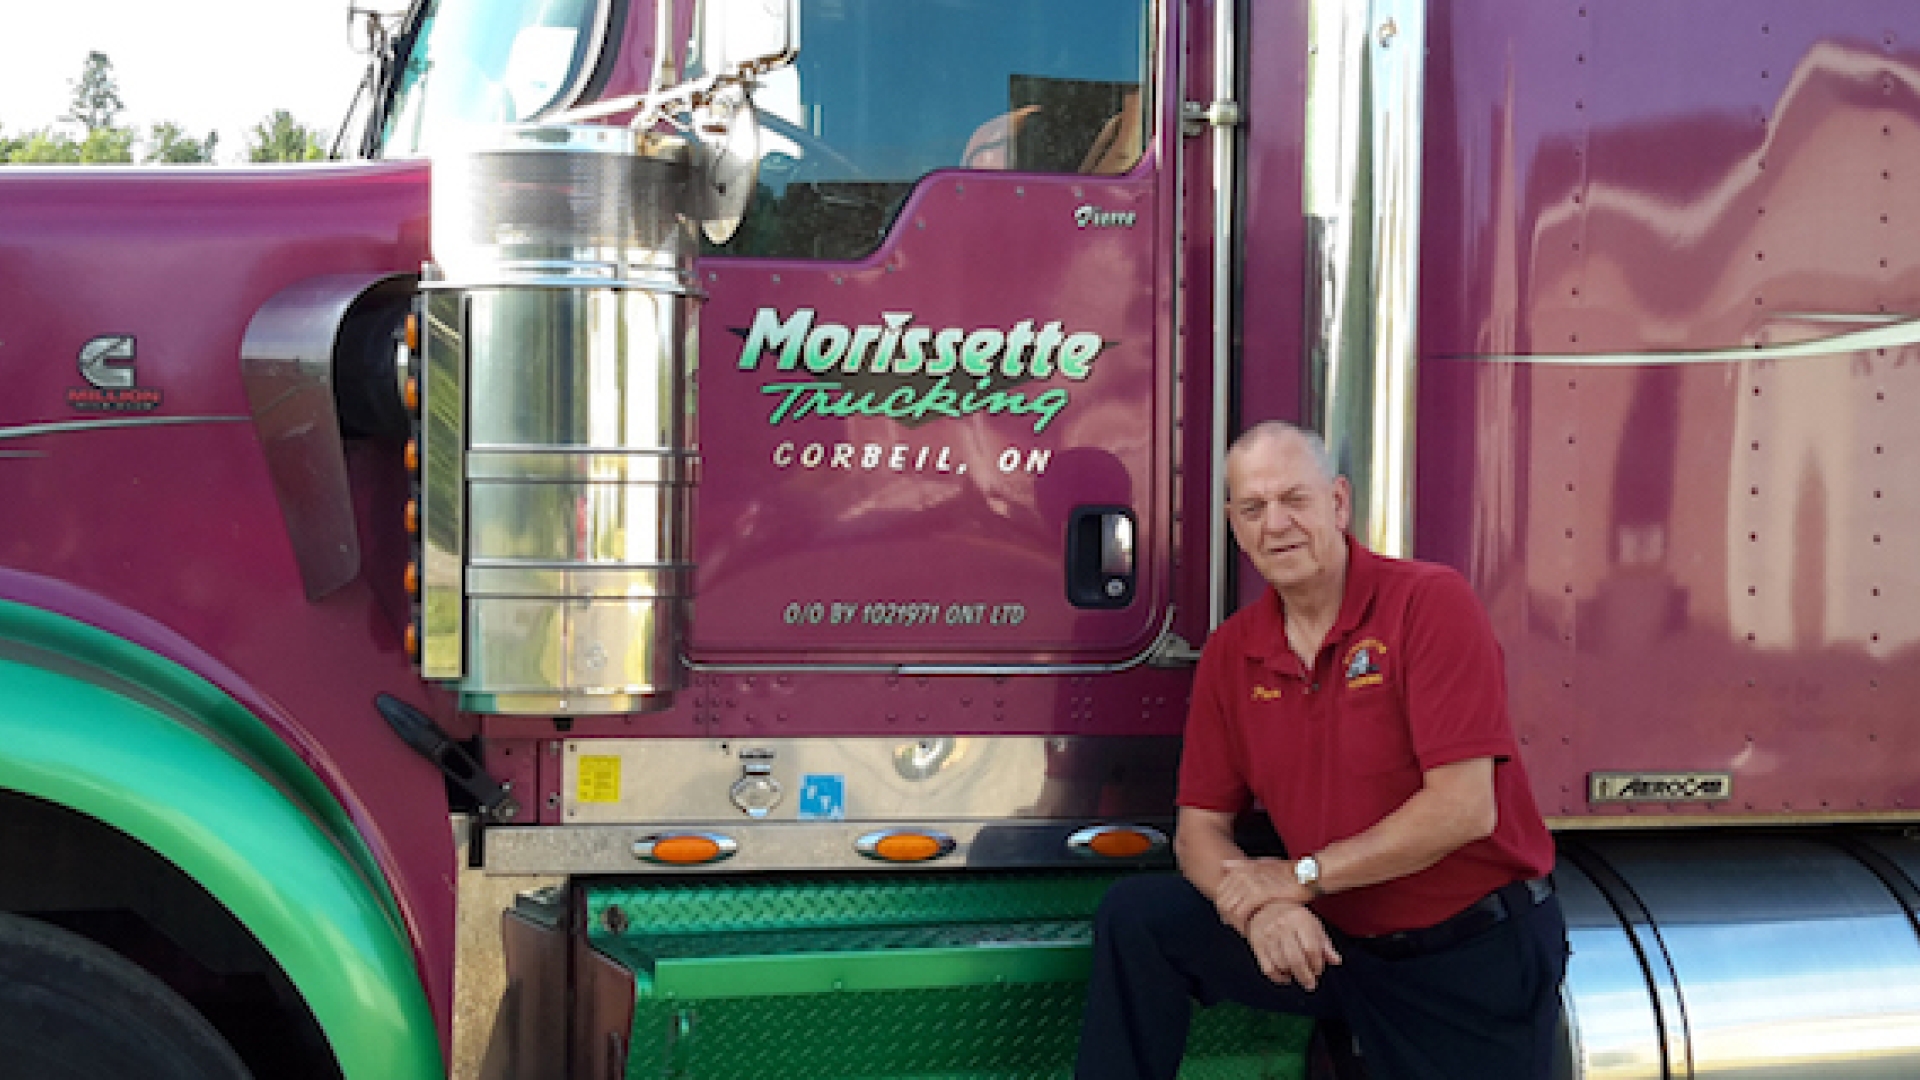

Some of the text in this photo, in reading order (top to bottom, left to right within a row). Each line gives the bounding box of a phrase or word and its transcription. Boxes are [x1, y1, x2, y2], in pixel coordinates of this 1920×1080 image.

[737, 307, 1103, 379] Morissette
[760, 376, 1069, 434] Trucking
[773, 442, 1053, 475] CORBEIL, ON
[783, 602, 825, 625] O/O
[830, 602, 858, 624] BY
[945, 602, 987, 624] ONT
[990, 603, 1027, 624] LTD
